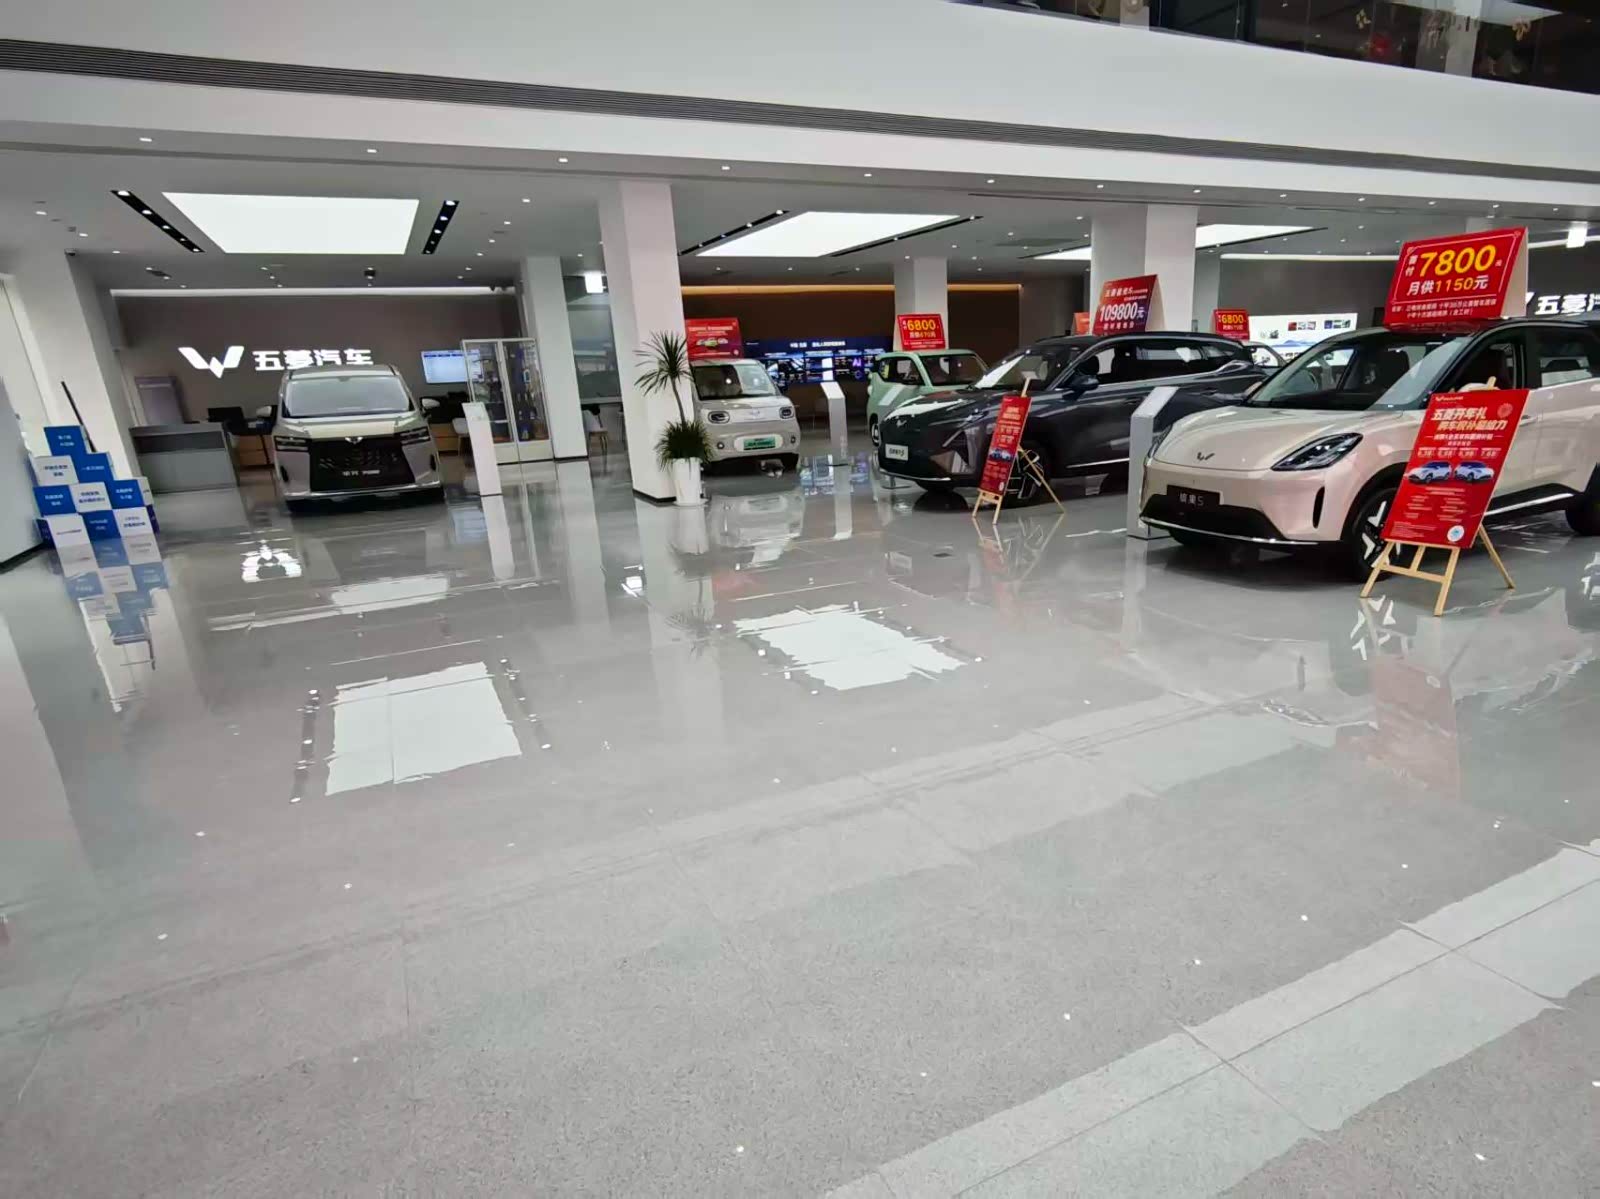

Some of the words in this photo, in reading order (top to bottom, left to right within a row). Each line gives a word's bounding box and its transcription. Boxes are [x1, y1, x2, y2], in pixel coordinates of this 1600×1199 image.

[1419, 245, 1497, 277] 7800
[1406, 275, 1489, 296] 月供1150元
[1099, 302, 1145, 322] 109800元
[907, 319, 936, 331] 6800
[252, 348, 374, 371] 五菱汽车
